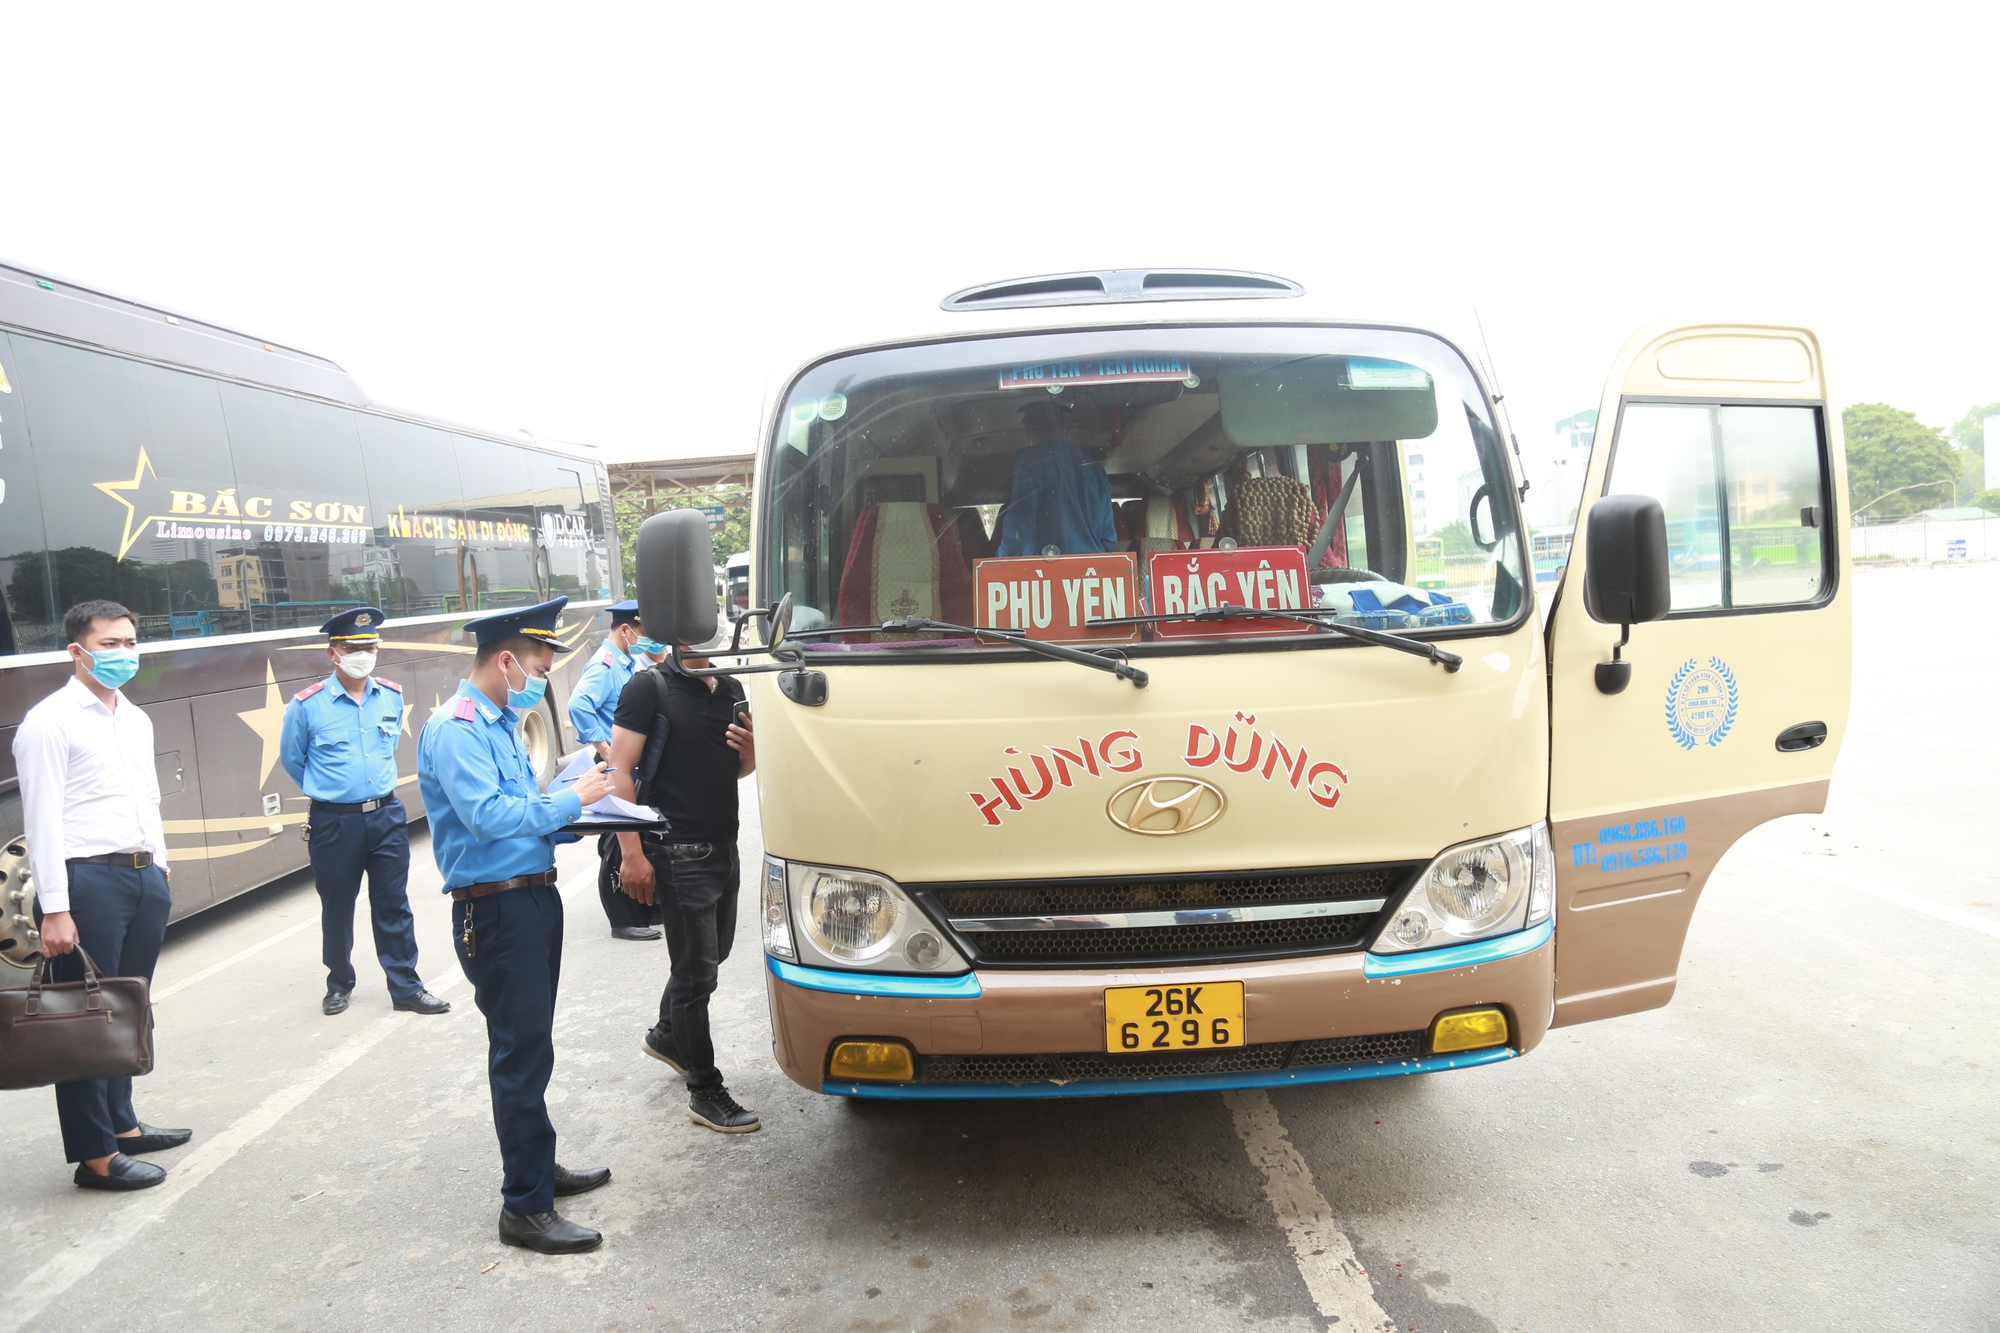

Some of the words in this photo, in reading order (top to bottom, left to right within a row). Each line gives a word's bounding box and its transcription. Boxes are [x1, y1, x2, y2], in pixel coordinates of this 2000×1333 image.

[168, 488, 273, 518] BẮC
[289, 500, 366, 524] SƠN
[156, 521, 252, 541] Limousine
[447, 519, 478, 546] SẠN
[480, 521, 495, 541] DI
[497, 518, 531, 547] ĐỘNG
[554, 514, 589, 543] DCAR
[987, 569, 1052, 630] PHÙ
[1062, 567, 1127, 627] YÊN
[1163, 557, 1228, 624] BẮC
[1236, 559, 1302, 621] YÊN
[966, 728, 1144, 827] HÙNG
[1180, 710, 1350, 810] DŨNG
[1145, 987, 1204, 1017] 26K
[1121, 1018, 1229, 1049] 6296
